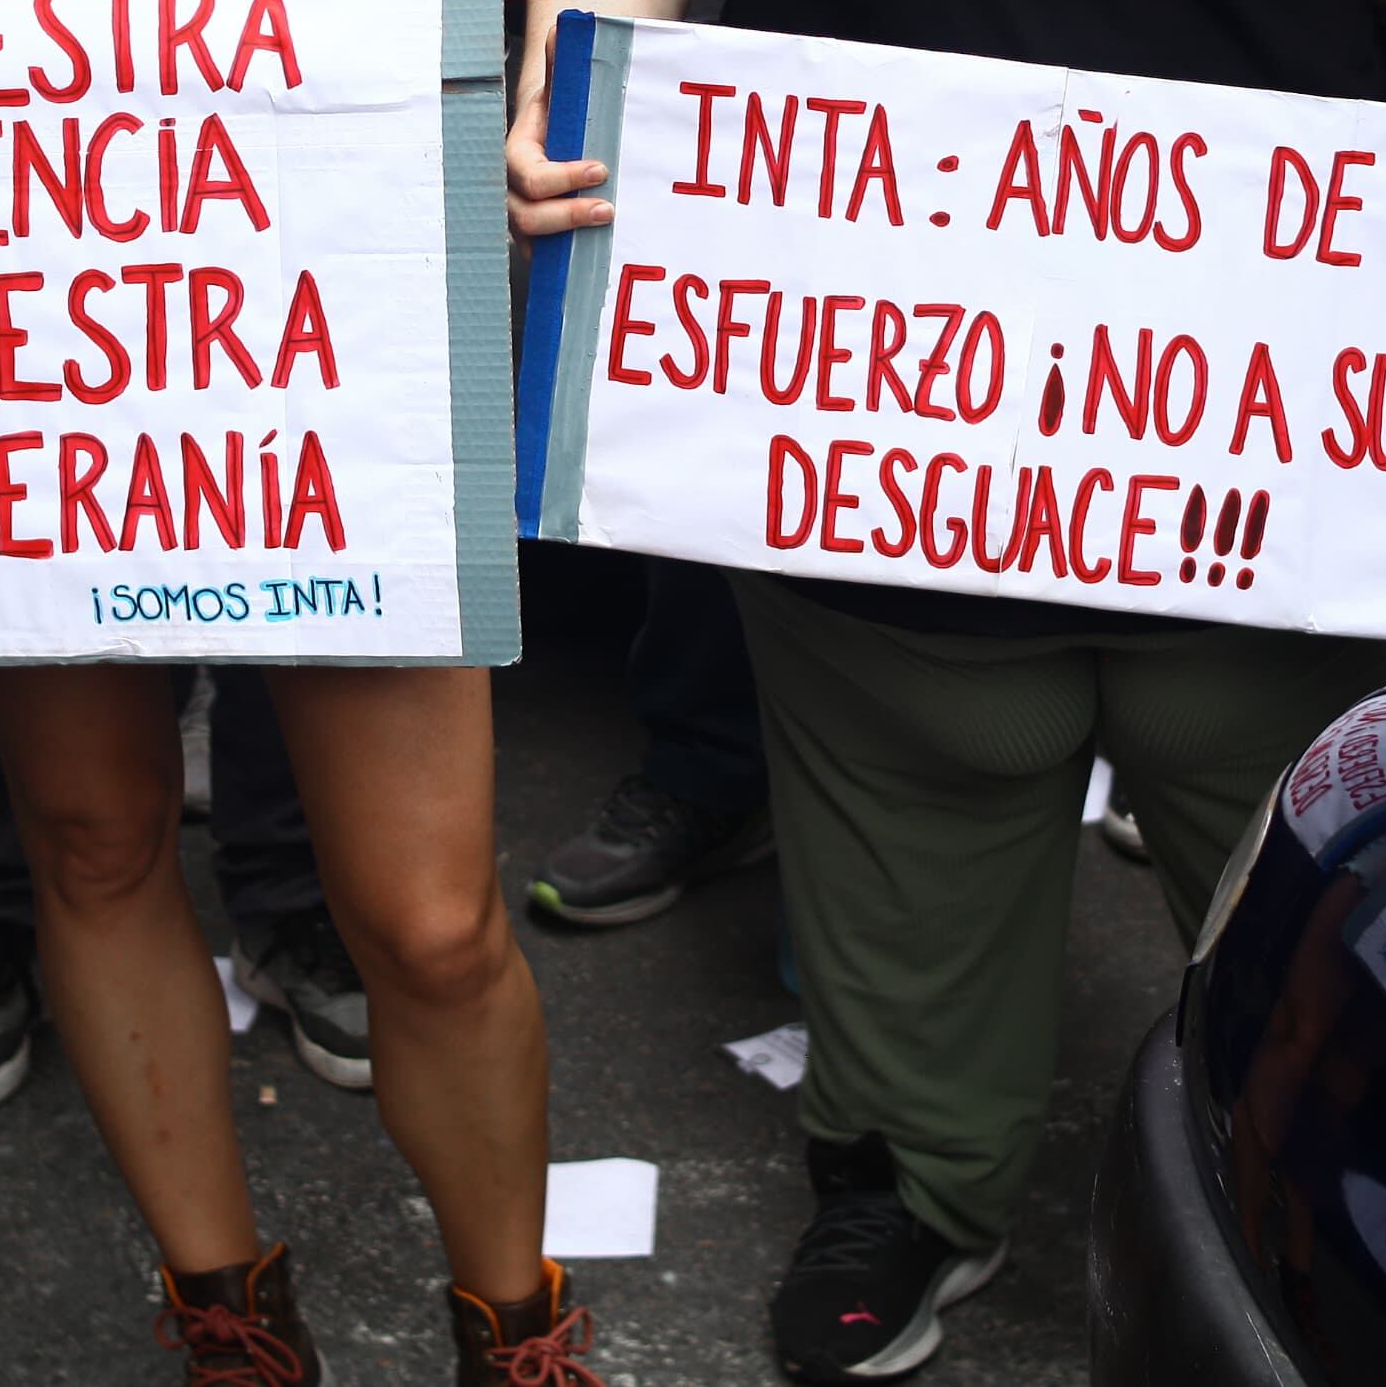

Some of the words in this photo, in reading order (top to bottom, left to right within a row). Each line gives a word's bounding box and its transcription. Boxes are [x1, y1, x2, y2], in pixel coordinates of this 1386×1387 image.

[986, 108, 1208, 252] AÑOS
[1263, 145, 1375, 266] DE
[608, 263, 1006, 425] ESFUERZO
[1037, 323, 1209, 446] ¡NO
[1229, 341, 1292, 463] A
[766, 434, 1270, 590] DESGUACE!!!
[92, 579, 251, 627] ¡SOMOS
